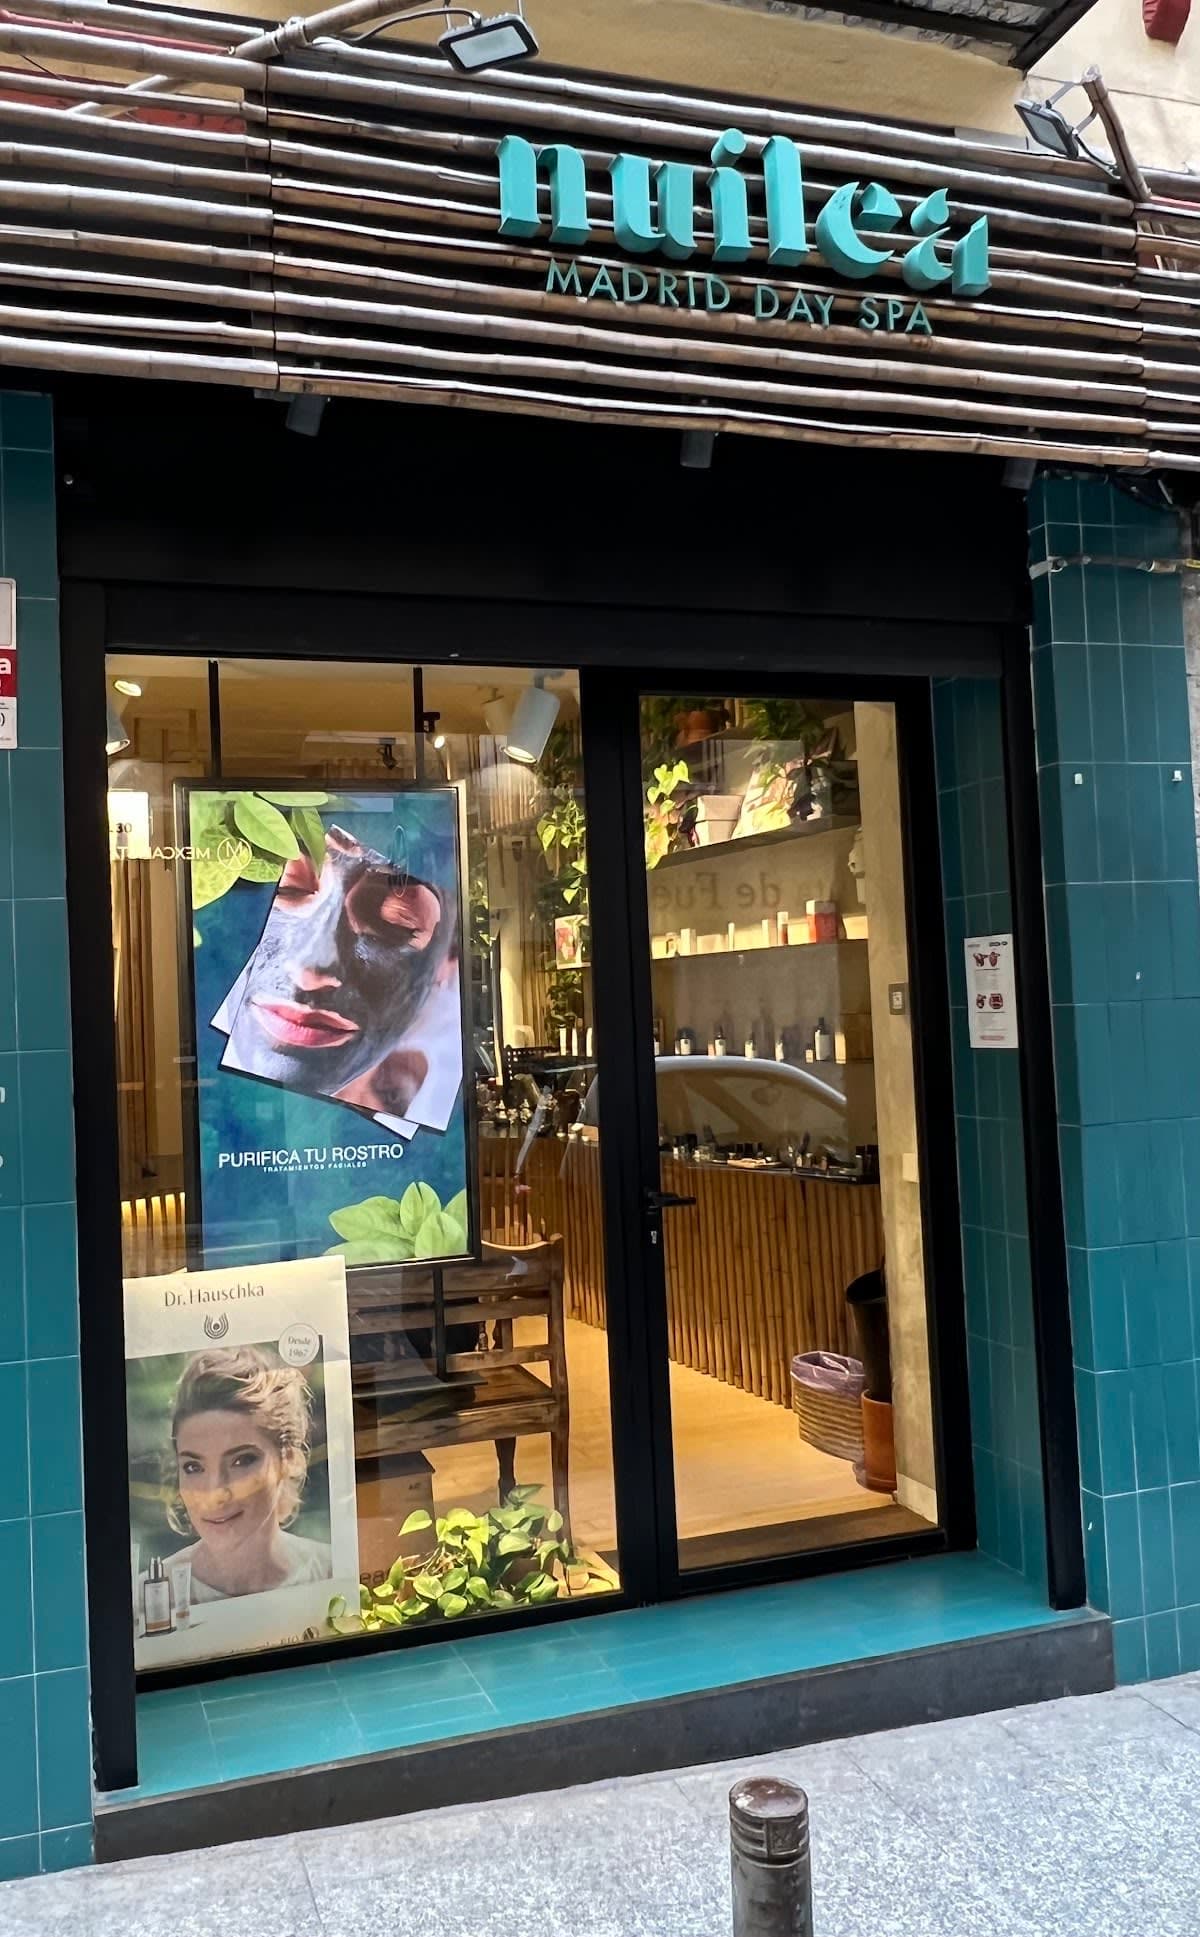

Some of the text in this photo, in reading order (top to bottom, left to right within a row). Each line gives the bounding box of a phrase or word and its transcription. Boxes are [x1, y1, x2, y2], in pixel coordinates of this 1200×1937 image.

[497, 128, 991, 295] nuilea
[545, 258, 933, 337] MADRID DAY SPA
[218, 1143, 404, 1169] PURIFICA TU ROSTRO
[263, 1161, 367, 1173] TRATAMIENTOS FACIALES
[164, 1282, 265, 1307] Dr. Hauschka
